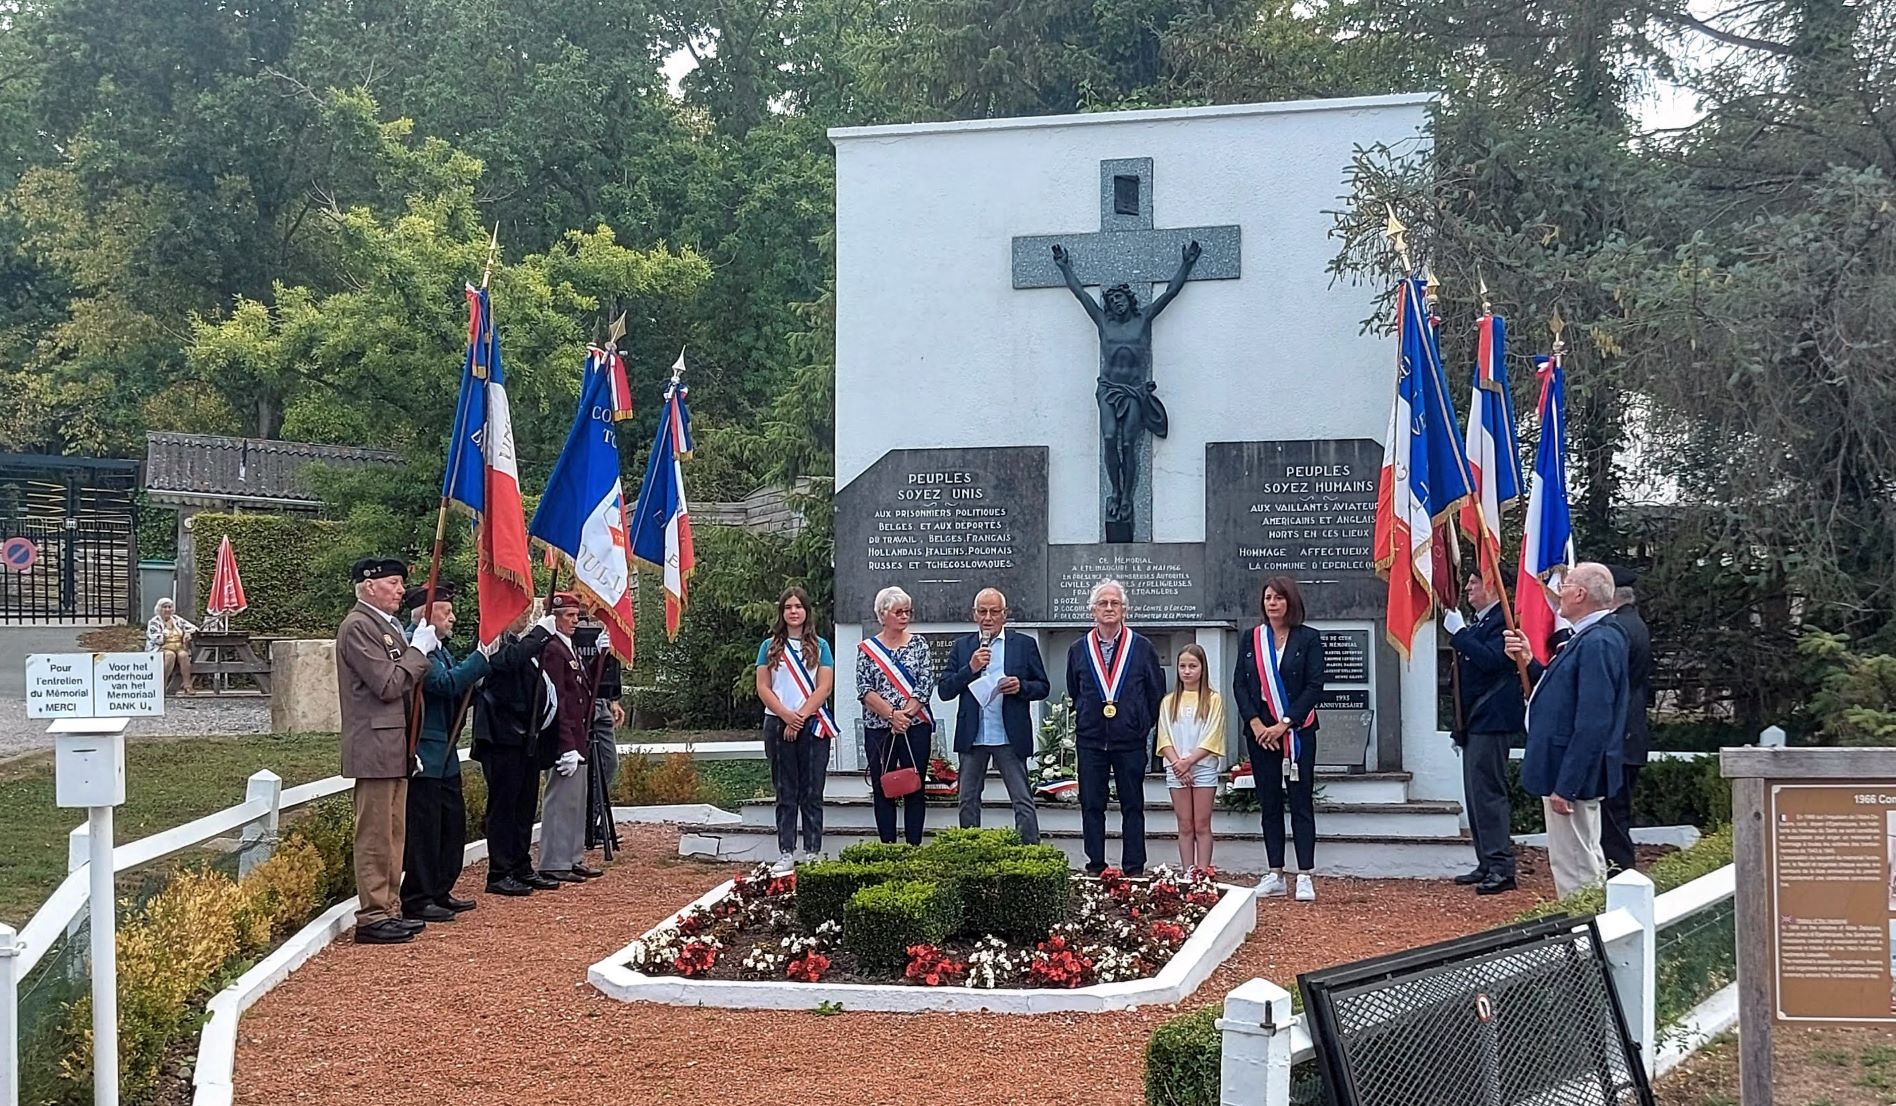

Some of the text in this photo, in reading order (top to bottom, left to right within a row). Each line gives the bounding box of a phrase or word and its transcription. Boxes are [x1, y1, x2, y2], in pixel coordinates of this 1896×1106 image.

[1286, 465, 1351, 478] PEUPLES
[908, 472, 972, 485] PEUPLES
[1264, 480, 1375, 494] SOYEZ HUMAINS
[897, 488, 984, 501] SOYEZ UNIS
[874, 507, 1007, 518] AUX PRISONNIERS POLITIQUES
[1250, 503, 1271, 512] AUX
[1274, 503, 1329, 512] VAILLANTS
[1319, 516, 1333, 525] ET
[1336, 515, 1377, 524] ANGLAIS
[920, 522, 932, 530] ET
[933, 521, 952, 530] AUX
[1268, 529, 1370, 539] MORTS EN CES LIEUX
[868, 536, 880, 544] DU
[868, 546, 923, 557] HOLLANDAIS
[968, 546, 1013, 555] POLONAIS
[1239, 546, 1370, 557] HOMMAGE AFFECTUEUX
[868, 560, 903, 571] RUSSES
[908, 560, 921, 570] ET
[1152, 564, 1166, 572] MAI
[1166, 564, 1181, 572] 1966
[1248, 562, 1262, 571] LA
[1264, 561, 1307, 570] COMMUNE
[1060, 580, 1091, 589] CIVILES
[50, 663, 73, 673] Pour
[108, 662, 149, 672] Voor het
[36, 676, 83, 687] l'entretien
[102, 672, 154, 682] onderhoud
[130, 681, 147, 691] het
[30, 688, 89, 699] du Mémorial
[107, 690, 156, 700] Memoriaal
[45, 702, 77, 713] MERCI
[109, 701, 147, 712] DANK U
[1854, 793, 1878, 805] 1966
